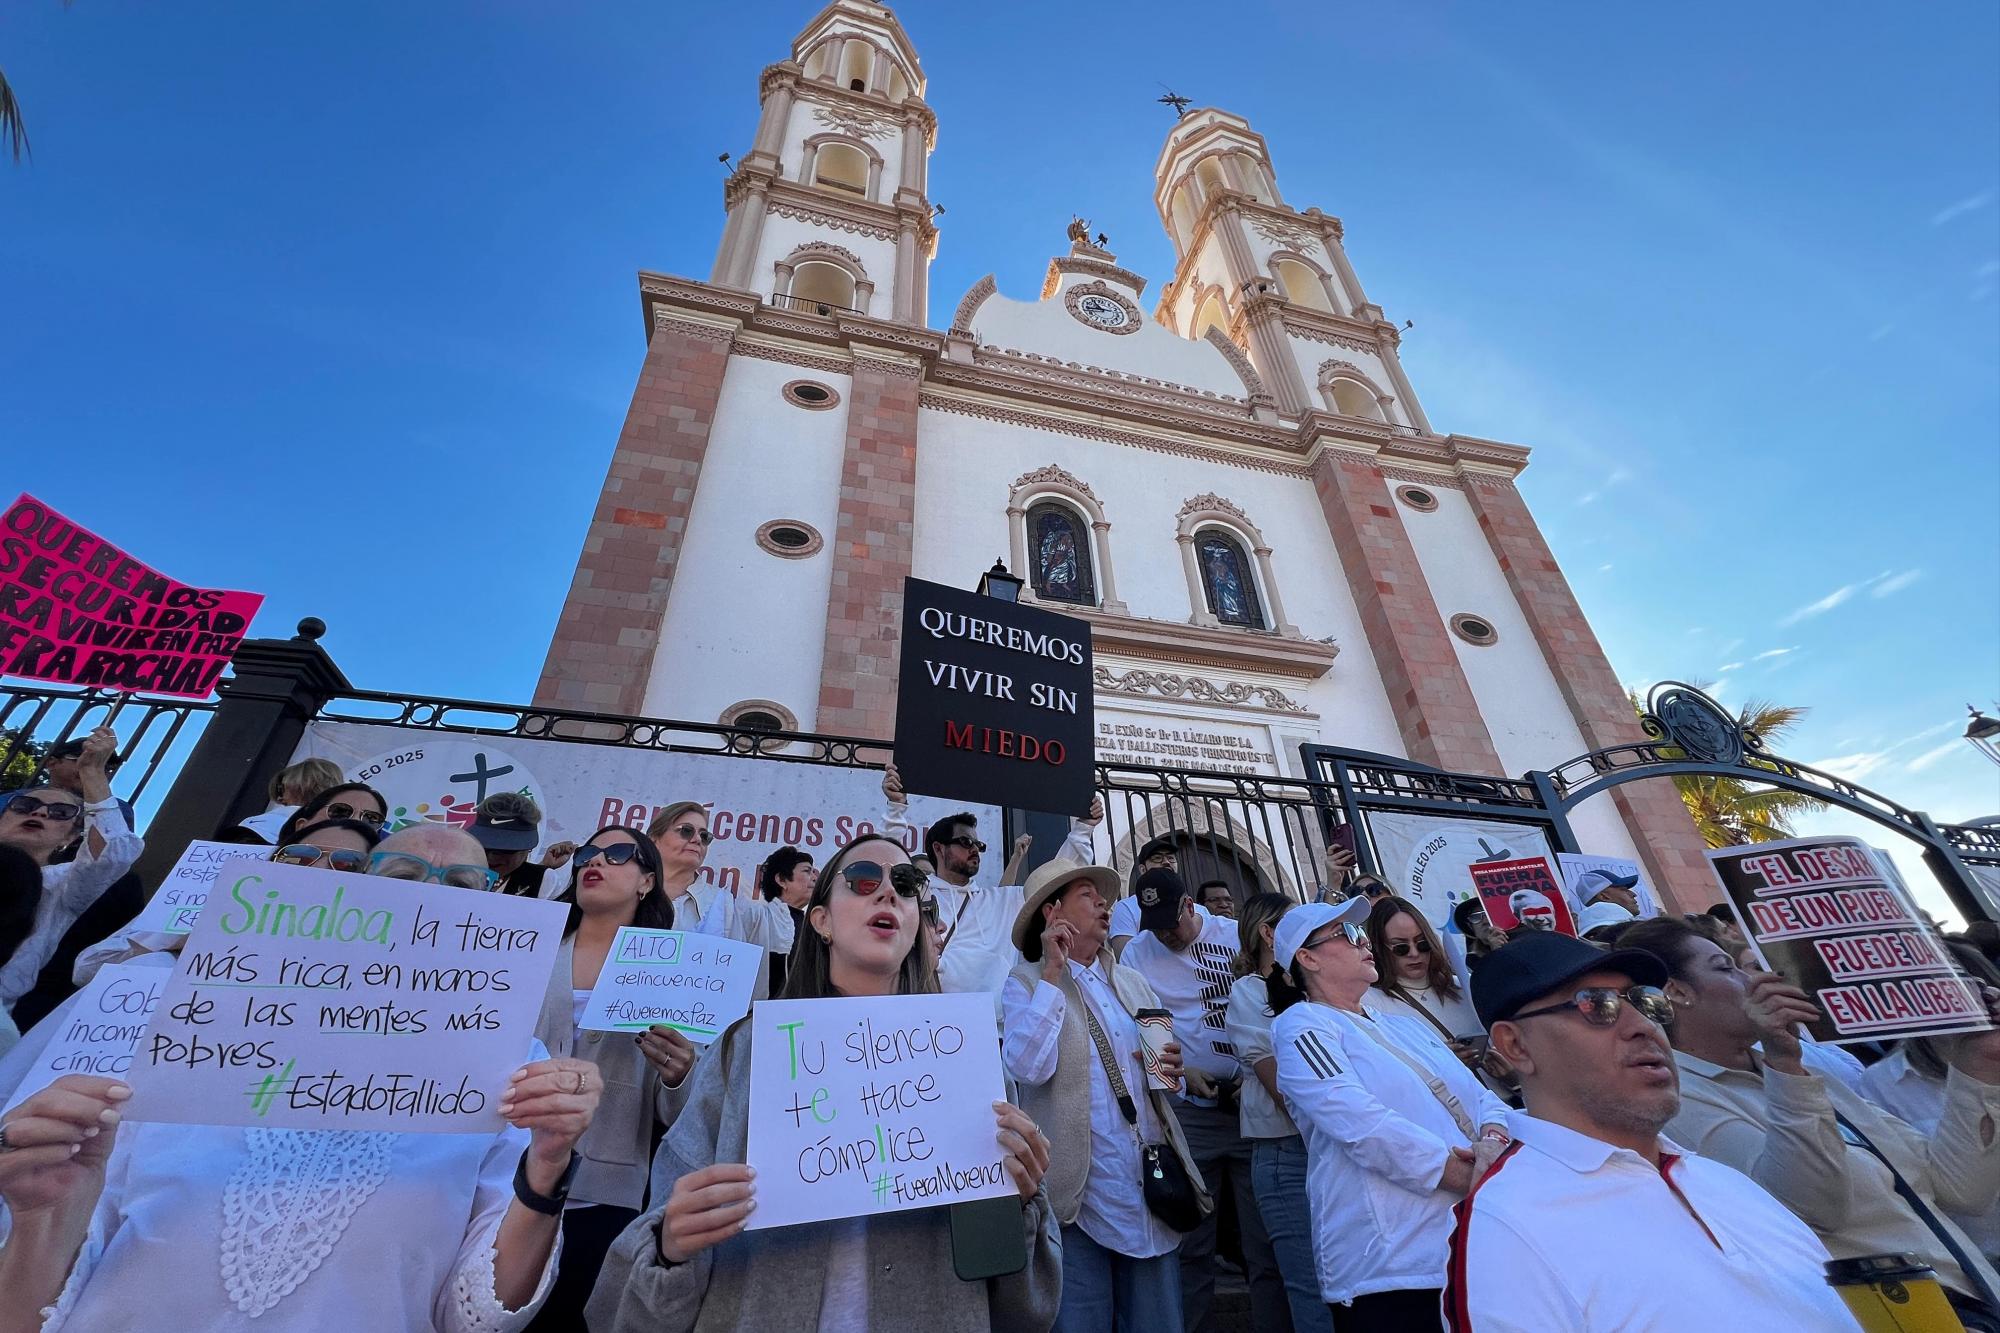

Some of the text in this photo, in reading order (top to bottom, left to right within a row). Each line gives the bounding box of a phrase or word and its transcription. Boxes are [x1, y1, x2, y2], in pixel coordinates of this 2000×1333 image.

[7, 502, 225, 609] QUEREMOS
[0, 538, 245, 634] SEGURIDAD
[57, 608, 156, 650] VIVIR
[157, 630, 195, 652] EN
[194, 633, 243, 656] PAZ
[920, 608, 1083, 665] QUEREMOS
[73, 651, 226, 694] ROCHA!
[924, 660, 1077, 715] VIVIR SIN
[944, 720, 1066, 765] MIEDO
[1099, 723, 1114, 735] EL
[1223, 736, 1238, 748] DE
[1238, 737, 1254, 749] LA
[1118, 739, 1125, 751] Y
[1127, 740, 1200, 758] BALLESTEROS
[385, 749, 424, 769] 2025
[598, 797, 823, 847] Becenos
[1412, 836, 1447, 900] JUBILEO 2025
[1475, 868, 1551, 887] FUERA
[220, 876, 538, 952] Sinaloa, la tierra
[1752, 902, 1800, 935] DE
[1796, 894, 1845, 929] UN
[623, 936, 732, 966] ALTO a la
[1819, 933, 1911, 976] PUEDE
[279, 956, 352, 990] rica,
[362, 961, 401, 987] en
[412, 966, 511, 992] manos
[615, 970, 725, 993] delincuencia
[170, 990, 216, 1024] de
[245, 997, 294, 1027] las
[320, 1000, 427, 1035] mentes
[605, 999, 717, 1026] #QueremosPaz
[1822, 988, 1874, 1024] EN
[1864, 982, 1910, 1020] LA
[777, 1018, 963, 1080] Tu silencio
[244, 1058, 485, 1116] #EstadoFallido
[785, 1087, 836, 1128] te
[871, 1160, 1005, 1206] #FueraMorena
